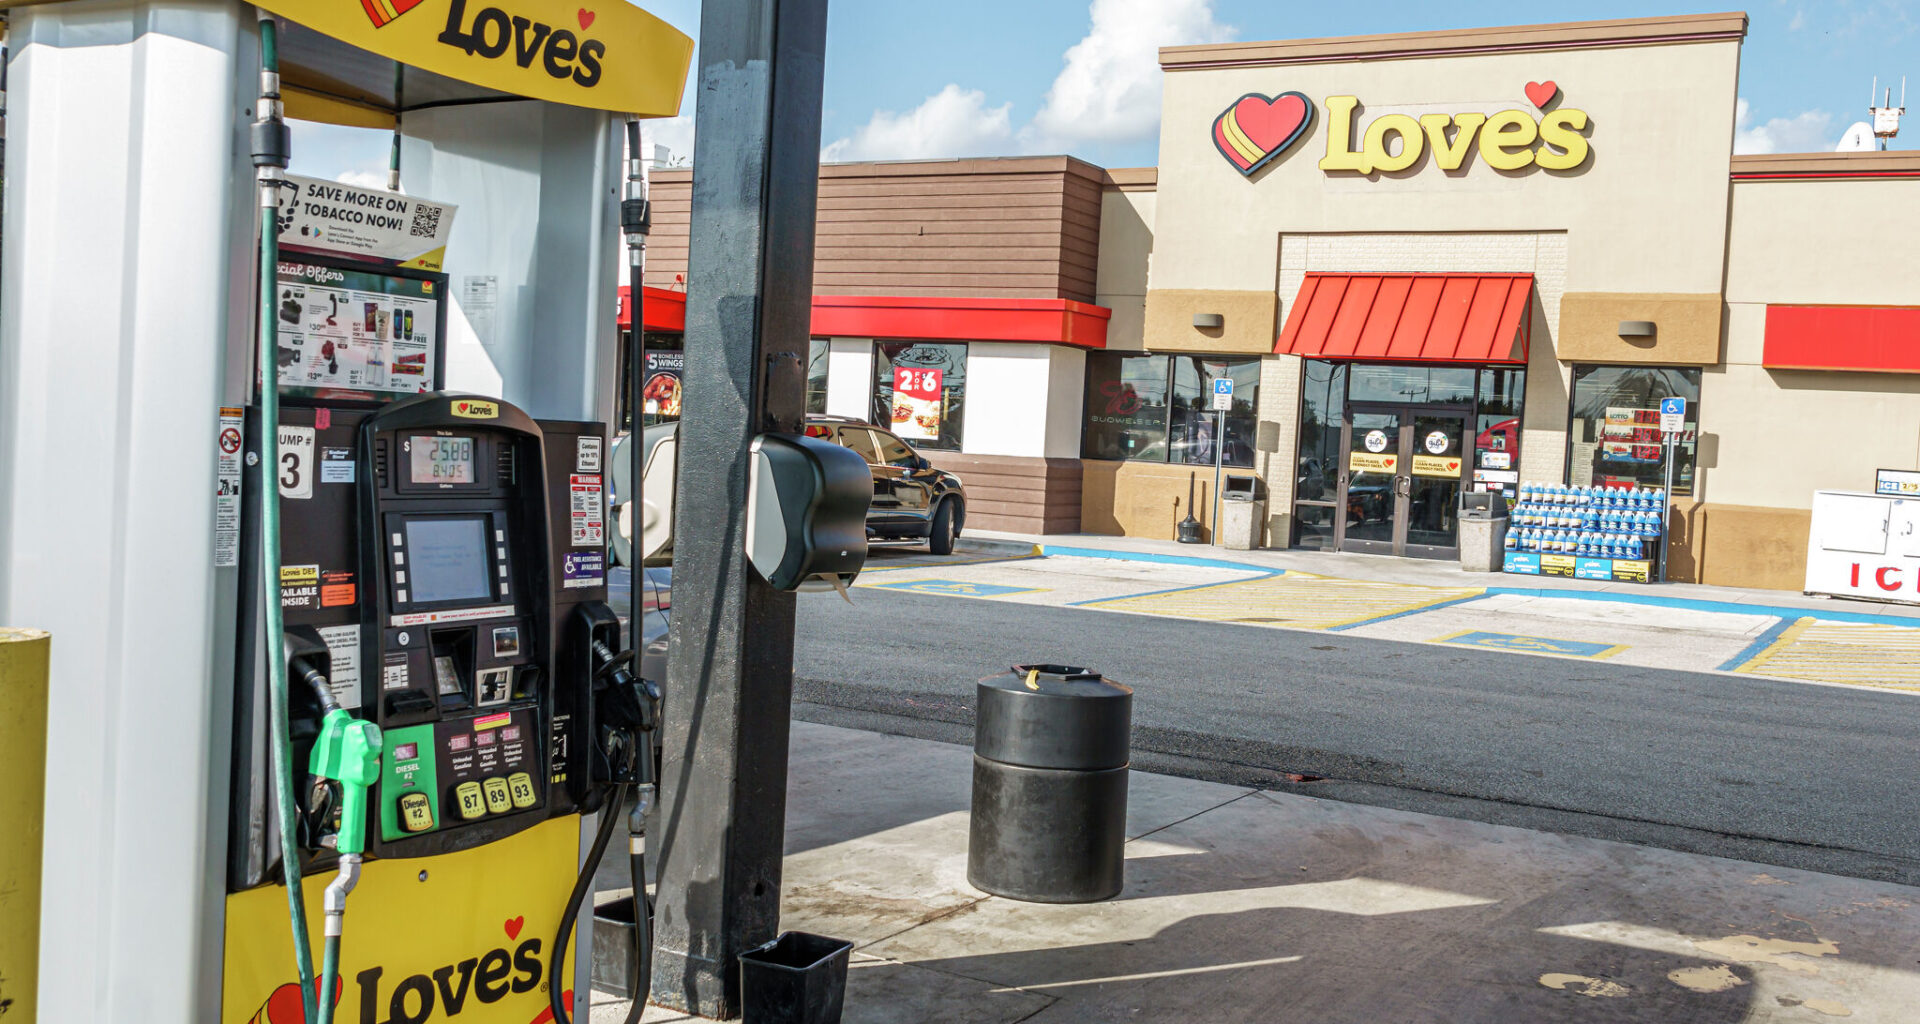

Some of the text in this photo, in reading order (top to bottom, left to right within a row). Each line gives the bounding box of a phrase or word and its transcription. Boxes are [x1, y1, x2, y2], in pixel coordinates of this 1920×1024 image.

[307, 183, 408, 214] SAVE MORE ON
[304, 202, 404, 231] TOBACCO NOW!
[277, 262, 345, 283] ecial Offers
[413, 335, 427, 343] FREE
[900, 370, 913, 391] 2
[921, 371, 937, 392] $6
[279, 434, 312, 446] UMP #
[403, 441, 410, 452] $
[280, 452, 300, 489] 3
[1850, 562, 1920, 594] IC
[281, 586, 318, 597] AILABLE
[281, 596, 310, 607] INSIDE
[478, 747, 497, 755] Unleaded
[503, 749, 523, 757] Unleaded
[452, 755, 473, 763] Unleaded
[480, 760, 497, 768] Gasoline
[505, 755, 522, 763] Gasoline
[395, 763, 420, 774] DIESEL
[454, 762, 472, 770] Gasoline
[404, 772, 413, 780] #2
[490, 789, 505, 804] 89
[514, 784, 530, 799] 93
[404, 797, 426, 809] Diesel
[463, 793, 478, 809] 87
[412, 808, 423, 819] #2
